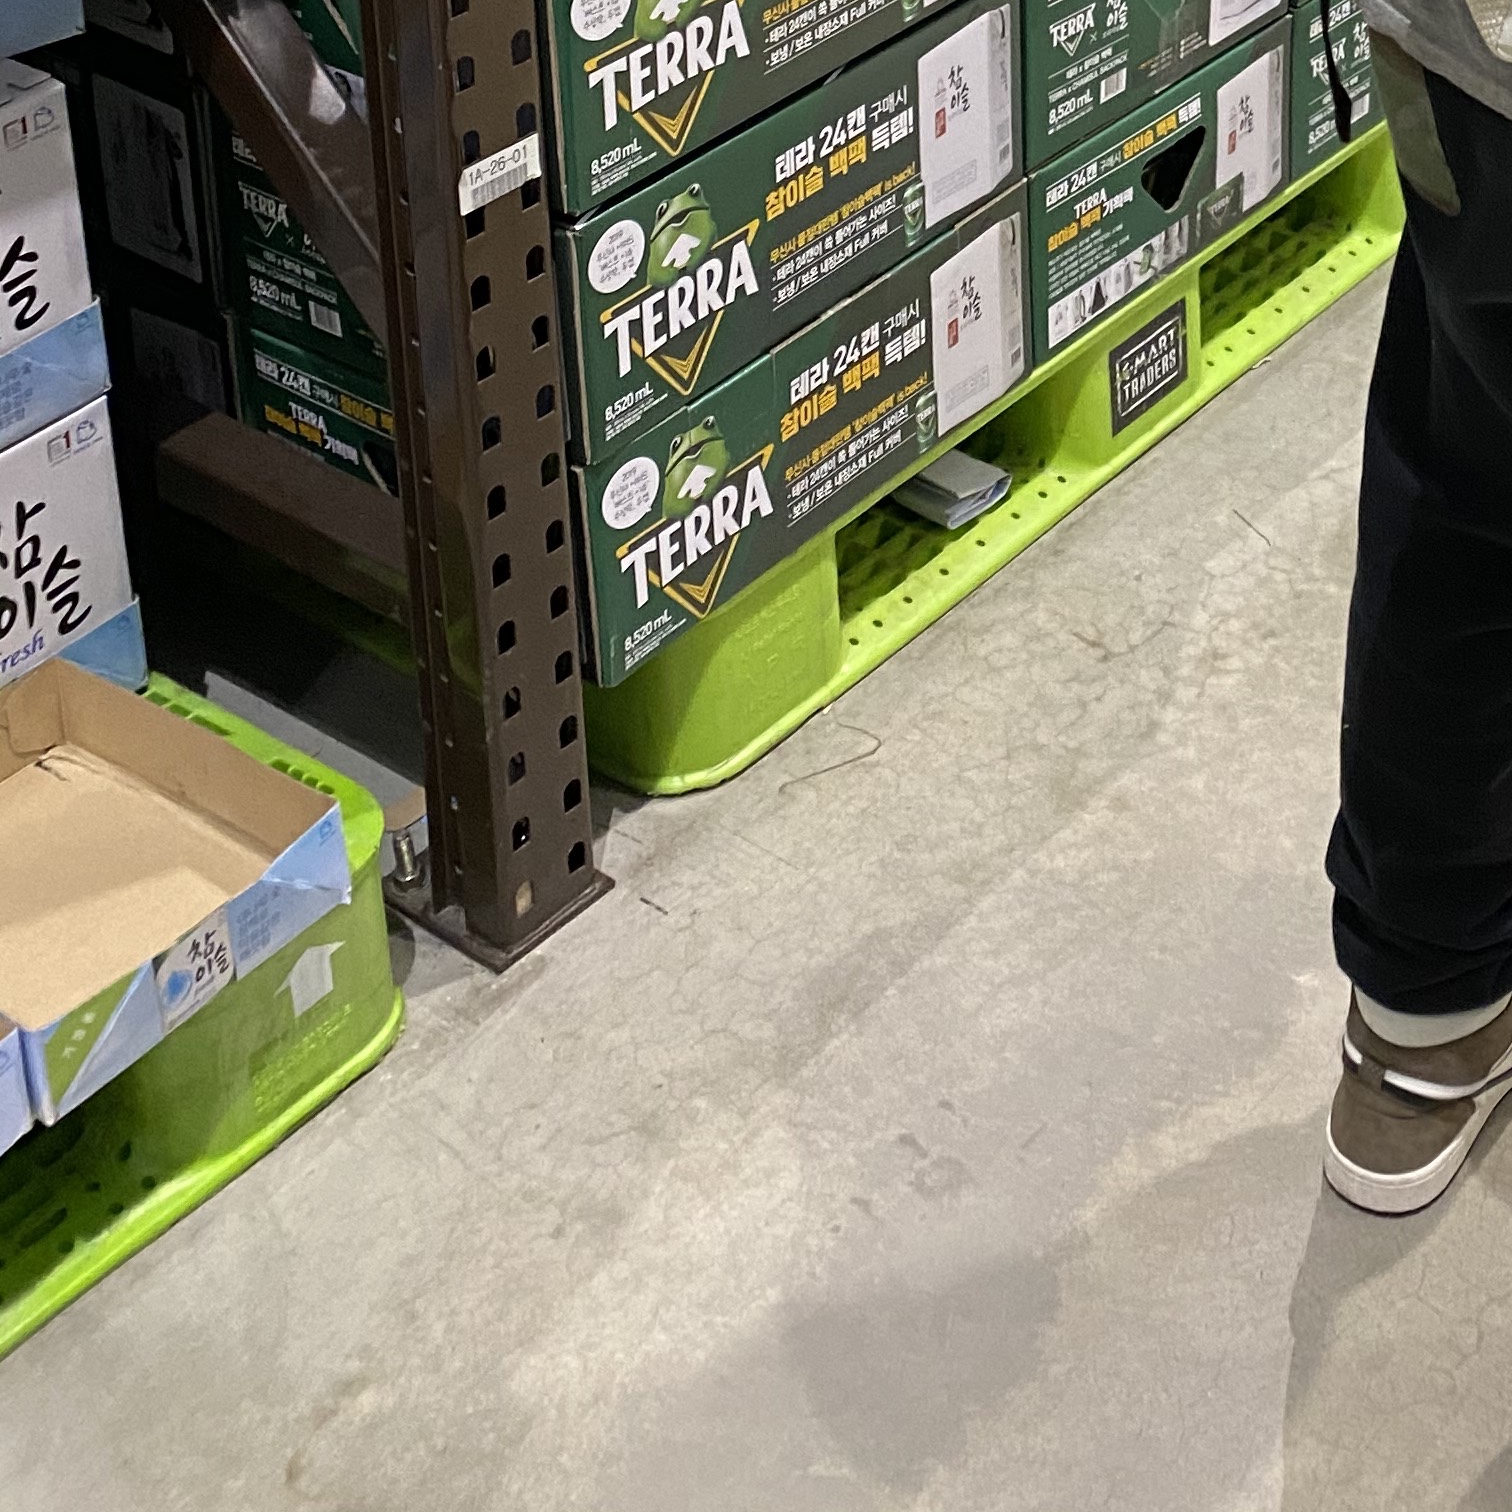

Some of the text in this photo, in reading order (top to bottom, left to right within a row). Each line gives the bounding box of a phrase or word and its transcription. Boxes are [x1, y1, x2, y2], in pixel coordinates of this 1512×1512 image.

[589, 1, 749, 129] TERRA
[469, 145, 527, 185] 1A-26-01
[604, 240, 757, 375] TERRA
[790, 357, 829, 404] 테라
[833, 322, 879, 376] 24캔
[1123, 348, 1176, 403] TRADERS
[622, 466, 772, 606] TERRA
